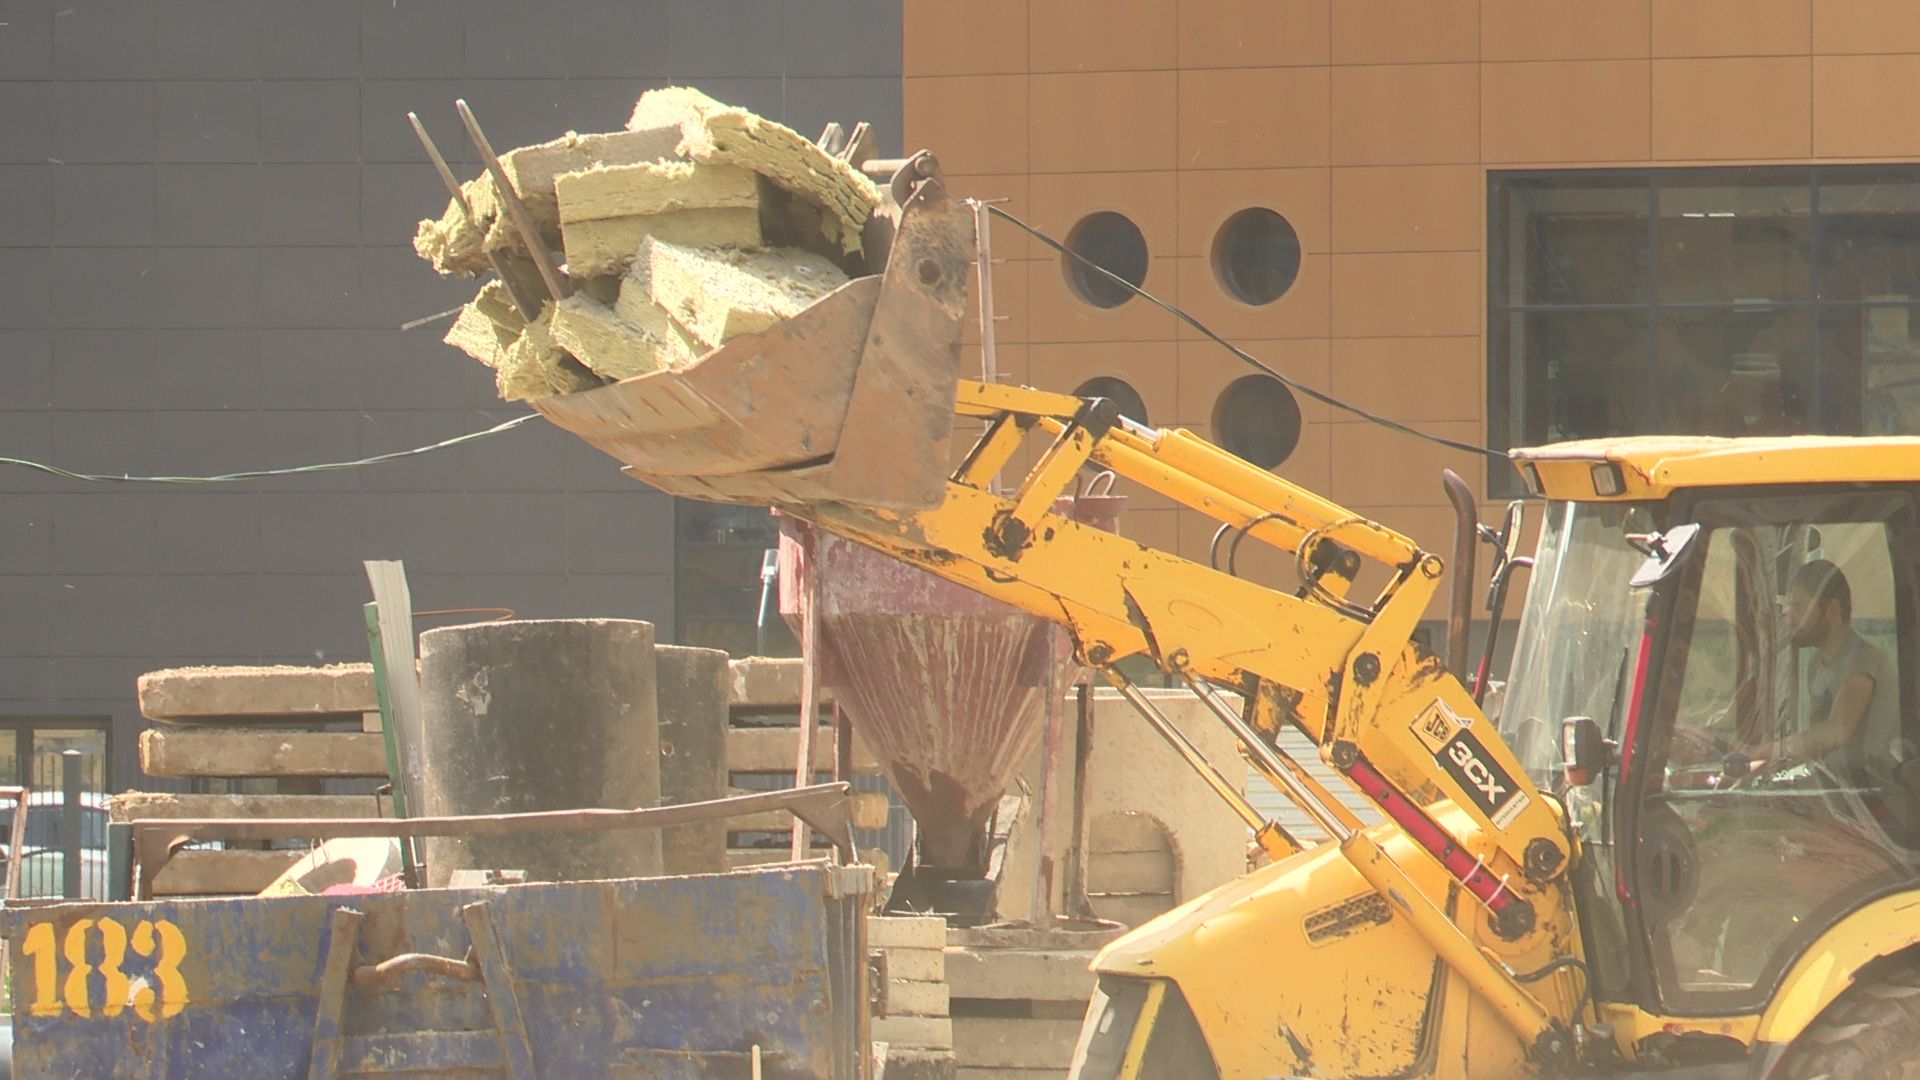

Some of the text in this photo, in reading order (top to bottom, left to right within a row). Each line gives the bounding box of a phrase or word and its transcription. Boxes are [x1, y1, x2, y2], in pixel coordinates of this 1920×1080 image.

[1426, 713, 1449, 740] JCB
[1448, 741, 1506, 804] 3CX
[22, 916, 190, 1023] 183
